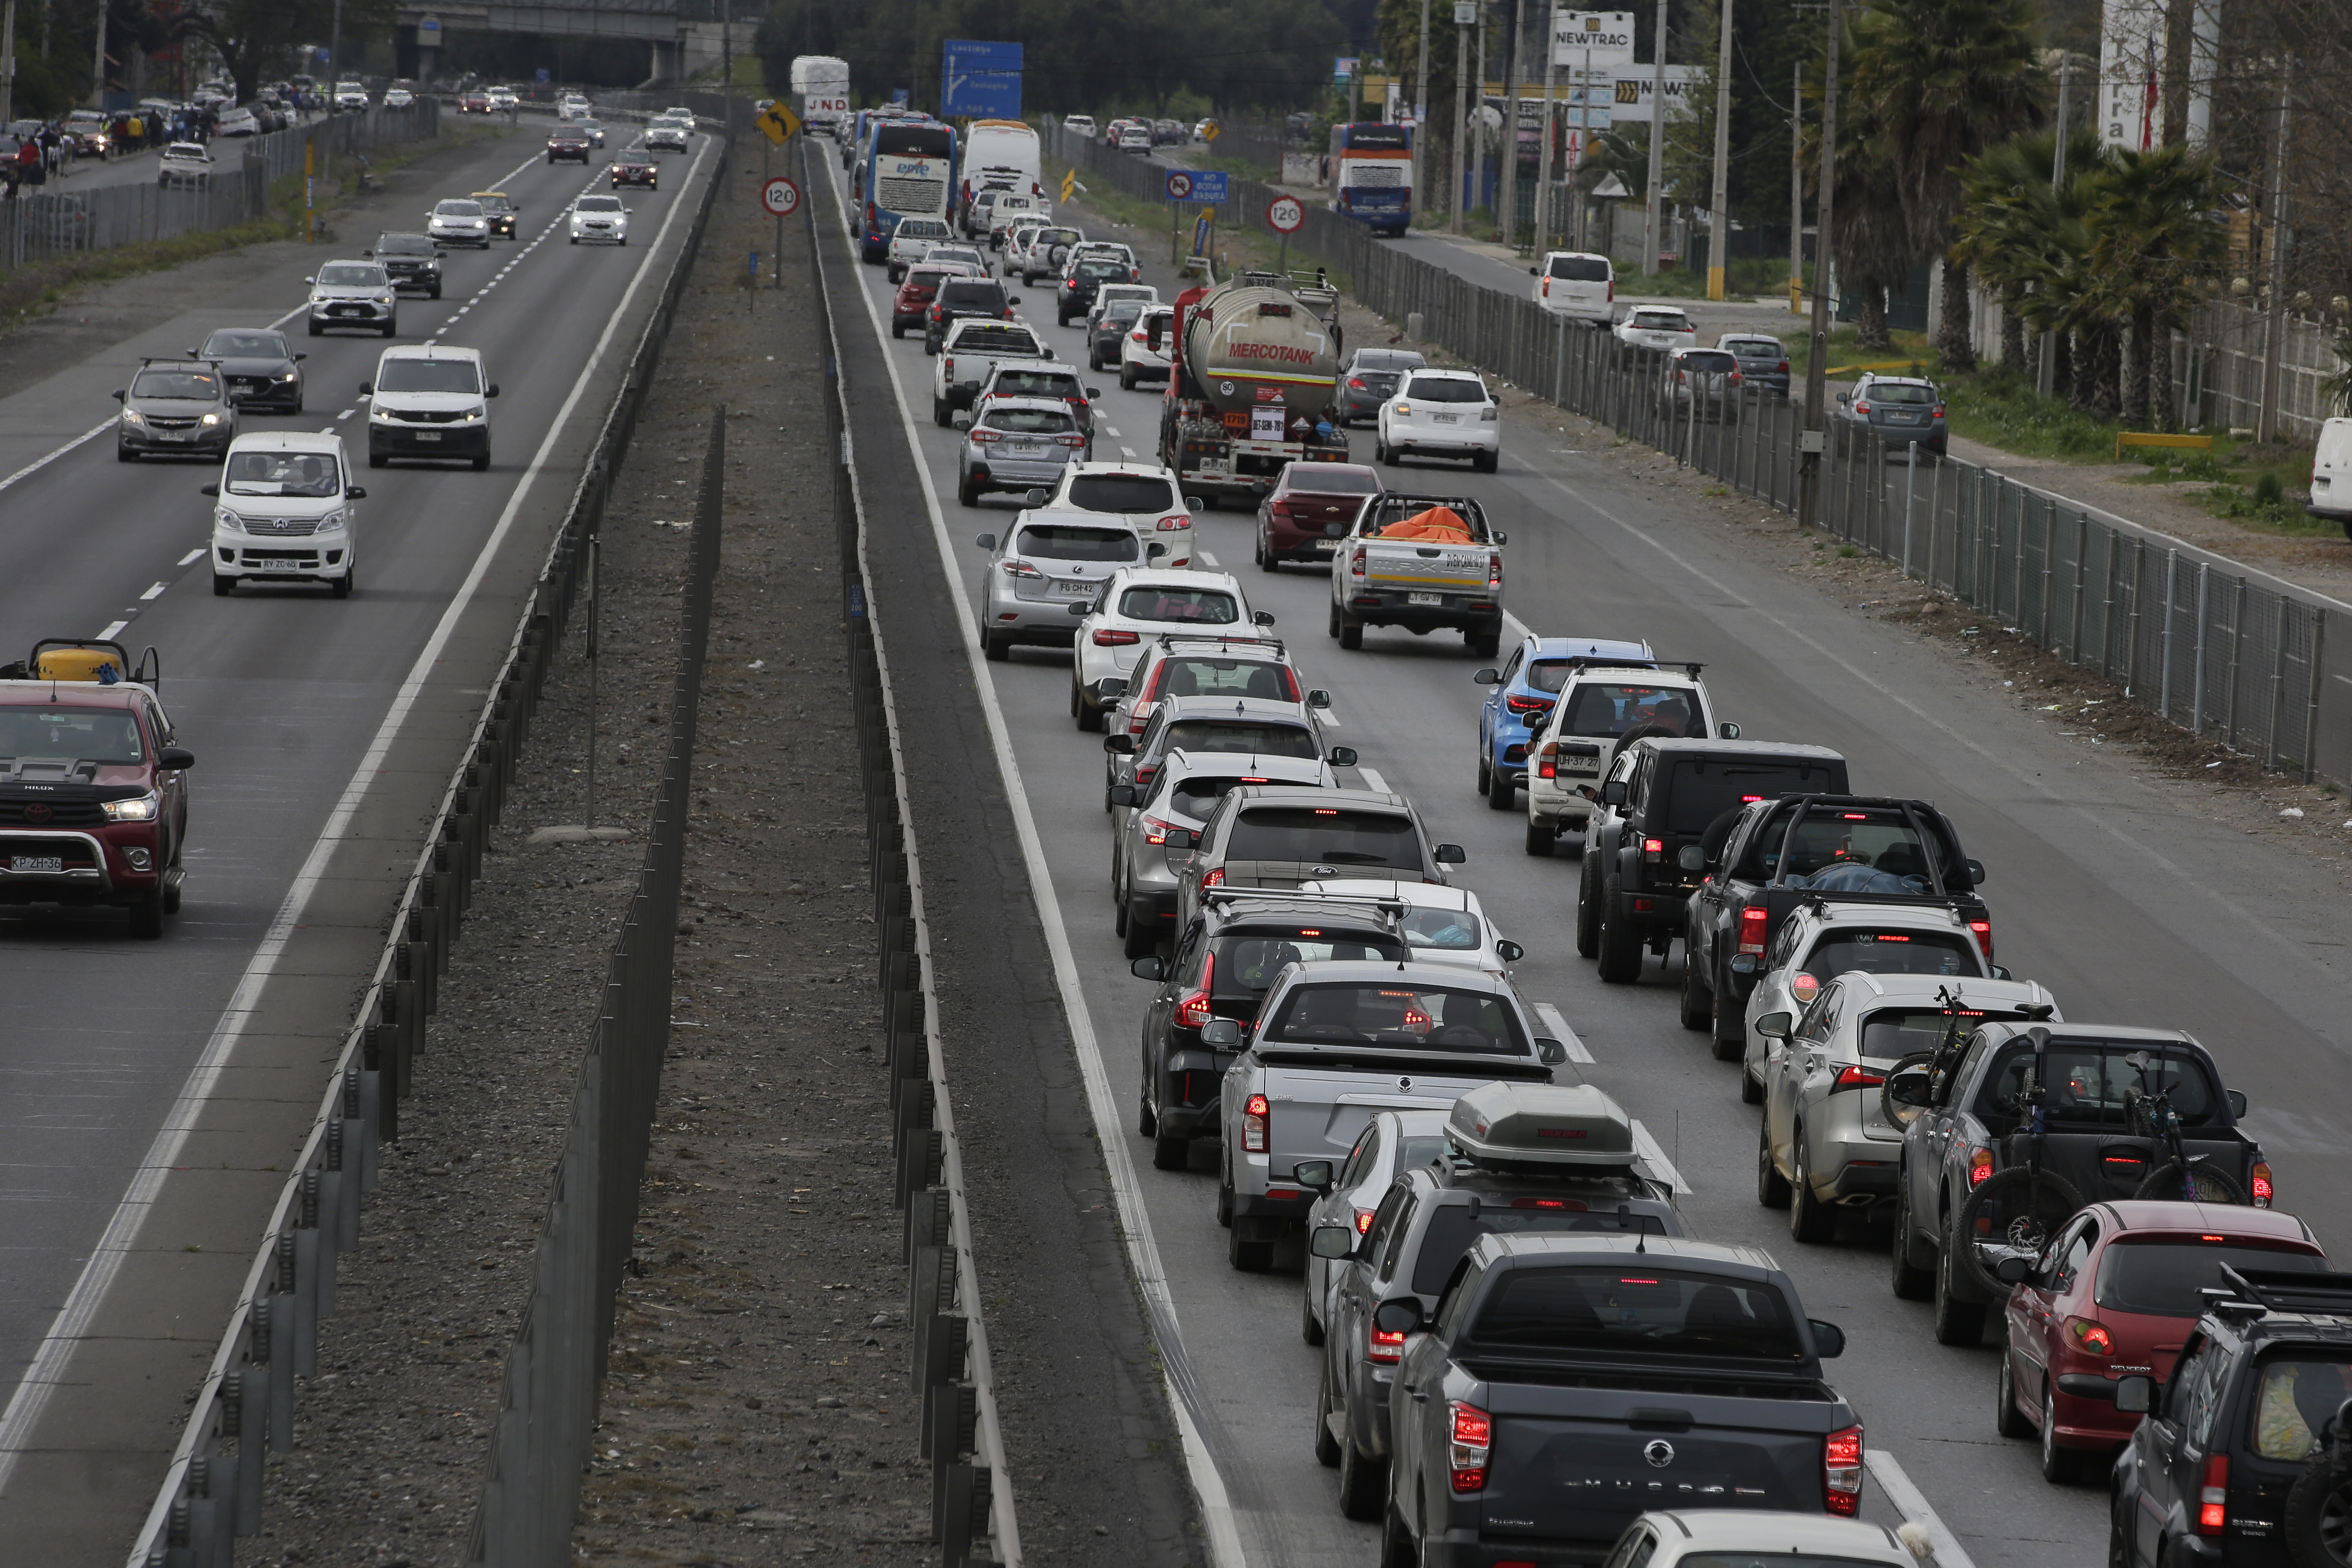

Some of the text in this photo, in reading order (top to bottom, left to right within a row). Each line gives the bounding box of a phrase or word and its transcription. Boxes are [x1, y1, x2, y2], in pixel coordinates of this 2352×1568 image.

[1556, 32, 1628, 45] NEWTRAC
[769, 189, 794, 203] 120
[1274, 206, 1298, 221] 120
[1229, 342, 1316, 365] MERCOTANK
[1226, 415, 1245, 424] 1719
[1538, 1129, 1587, 1138] YAKIMA
[1489, 1517, 1535, 1529] SSANGYONG
[2232, 1520, 2274, 1529] SUZUKI
